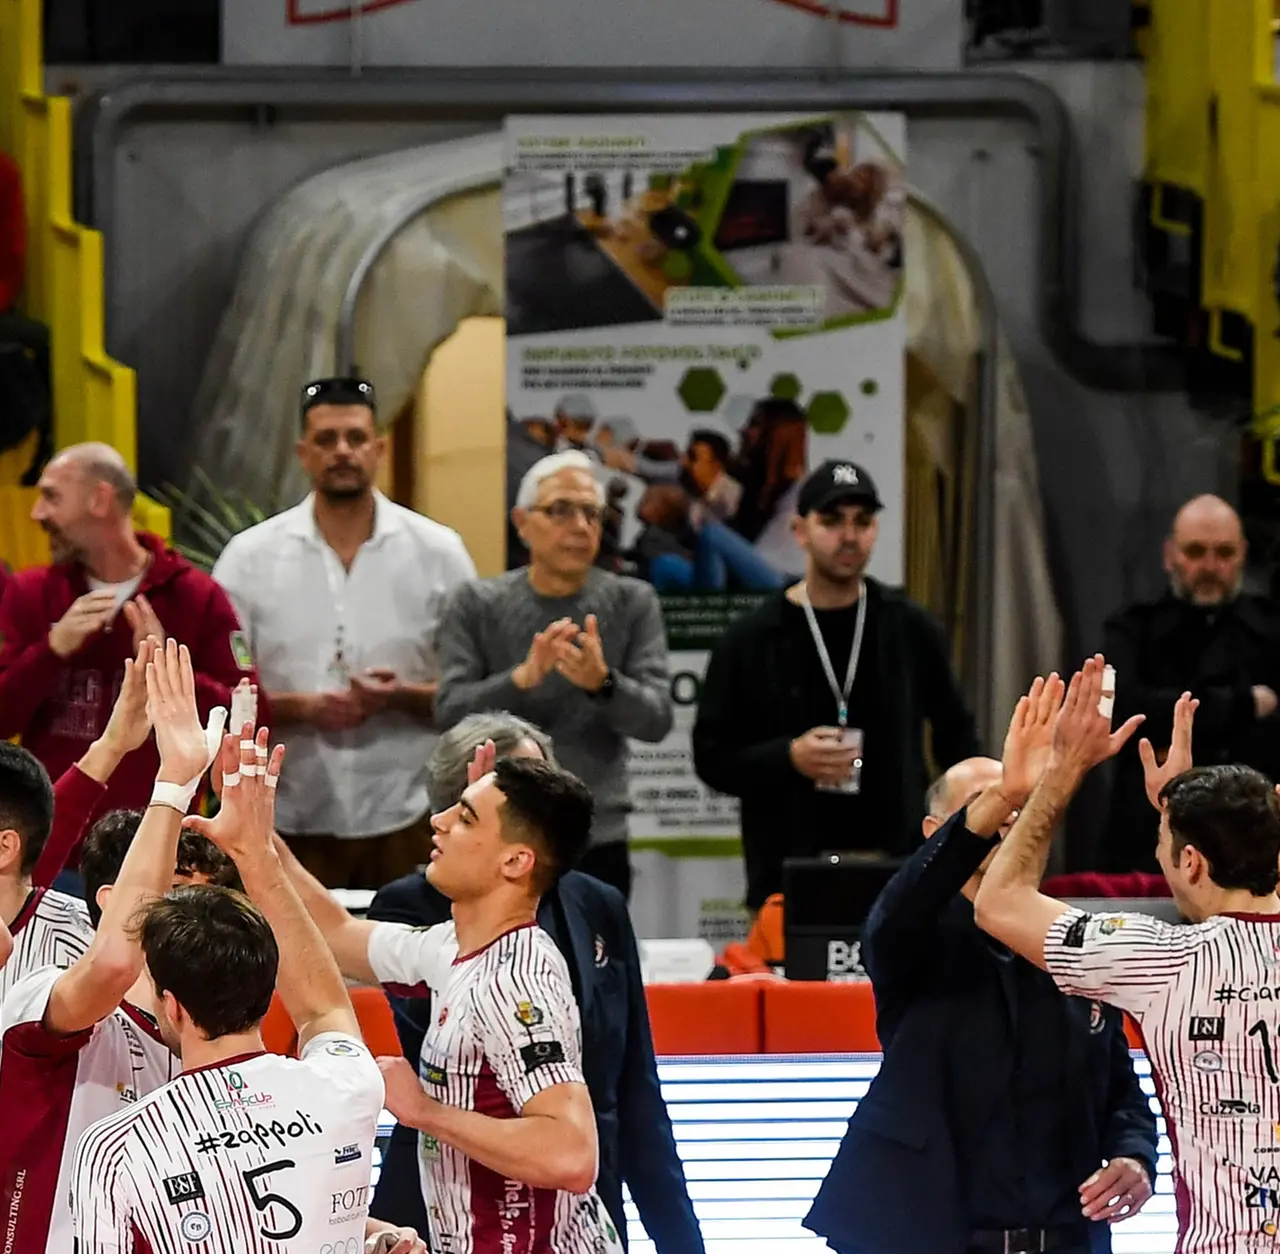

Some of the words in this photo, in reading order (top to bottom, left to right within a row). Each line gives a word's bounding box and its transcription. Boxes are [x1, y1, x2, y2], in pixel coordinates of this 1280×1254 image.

[194, 1110, 323, 1155] #zappoli
[14, 1168, 27, 1190] SRL
[242, 1159, 303, 1240] 5
